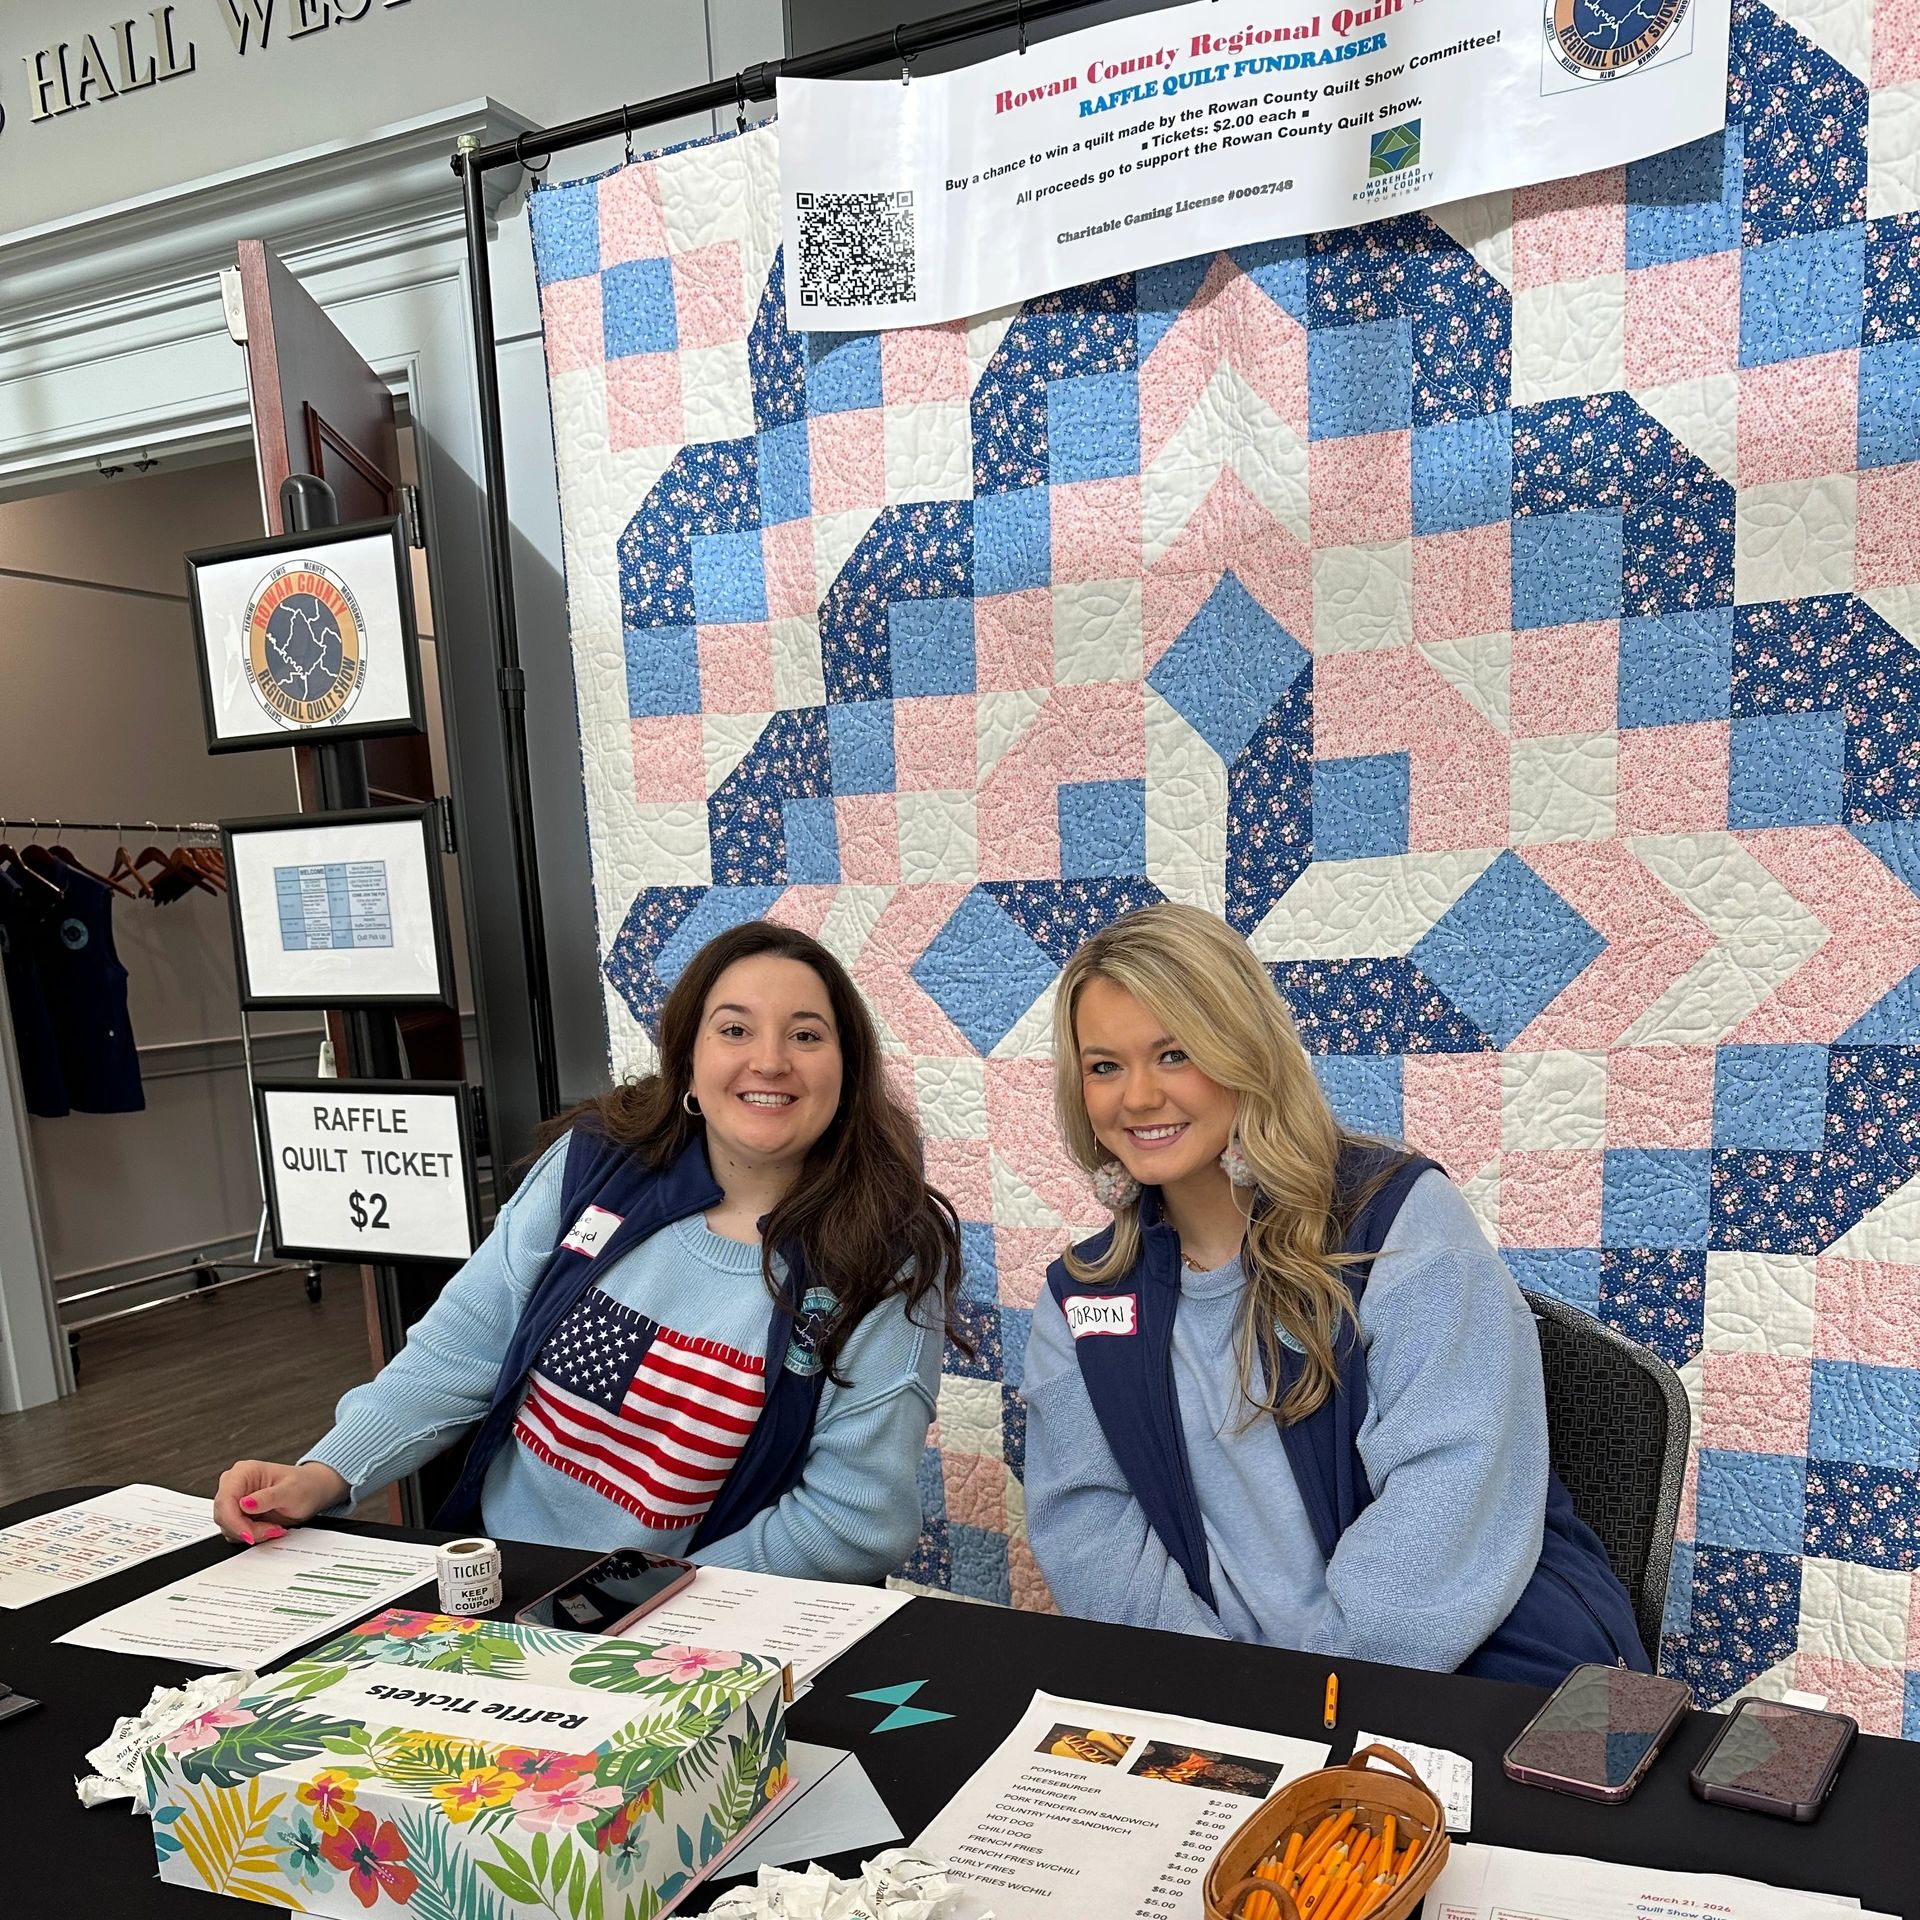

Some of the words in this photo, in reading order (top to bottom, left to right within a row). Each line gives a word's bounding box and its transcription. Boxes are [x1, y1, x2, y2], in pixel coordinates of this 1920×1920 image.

[1673, 0, 1688, 23] ORGAN
[1546, 17, 1556, 41] ELLIOTT
[1559, 24, 1608, 67] REGIONAL
[1612, 34, 1650, 66] QUILT
[1648, 0, 1678, 38] SHOW
[22, 6, 196, 124] HALL
[996, 73, 1077, 115] Rowan
[1087, 45, 1179, 85] County
[1189, 16, 1320, 59] Regional
[1332, 0, 1403, 37] Quilt
[1561, 56, 1581, 74] CARTER
[1638, 45, 1660, 66] ROWAN
[1079, 80, 1158, 118] RAFFLE
[1162, 64, 1230, 97] QUILT
[1234, 32, 1388, 80] FUNDRAISER
[1600, 70, 1616, 79] BATH
[945, 176, 969, 191] Buy
[972, 174, 980, 184] a
[983, 158, 1025, 182] chance
[1030, 151, 1042, 165] to
[1045, 144, 1068, 160] win
[1073, 141, 1081, 152] a
[1084, 128, 1115, 152] quilt
[1118, 119, 1155, 140] made
[1160, 114, 1176, 129] by
[1180, 107, 1203, 123] the
[1208, 98, 1258, 117] Rowan
[1263, 89, 1318, 107] County
[1323, 78, 1360, 97] Quilt
[1364, 64, 1404, 87] Show
[1409, 29, 1501, 70] Committee!
[1151, 125, 1209, 148] Tickets:
[1213, 114, 1254, 133] $2.00
[1258, 108, 1296, 124] each
[1016, 192, 1032, 205] All
[1035, 173, 1095, 202] proceeds
[1098, 168, 1115, 185] go
[1119, 162, 1132, 174] to
[1136, 148, 1190, 171] support
[1194, 142, 1217, 156] the
[1222, 130, 1272, 149] Rowan
[1278, 121, 1333, 140] County
[1338, 111, 1375, 130] Quilt
[1379, 97, 1422, 118] Show.
[1352, 186, 1389, 201] ROWAN
[1394, 171, 1435, 191] COUNTY
[1366, 168, 1421, 191] MOREHEAD
[1366, 186, 1421, 205] TOURISM
[1057, 217, 1121, 245] Charitable
[1124, 205, 1173, 228] Gaming
[1175, 193, 1225, 215] License
[1228, 179, 1294, 202] #0002748
[270, 566, 287, 581] LEWIS
[304, 562, 327, 576] MENIFEE
[244, 602, 256, 633] FLEMING
[254, 576, 294, 630] ROWAN
[297, 574, 348, 617] COUNTY
[340, 585, 365, 632] MONTGOMERY
[258, 669, 304, 719] REGIONAL
[306, 692, 337, 721] QUILT
[333, 656, 356, 699] SHOW
[354, 659, 366, 690] MORGAN
[313, 1106, 408, 1133] RAFFLE
[282, 1146, 348, 1172] QUILT
[361, 1150, 453, 1178] TICKET
[349, 1189, 390, 1232] $2
[1068, 1305, 1124, 1329] JORDYN
[453, 1561, 491, 1579] TICKET
[455, 1597, 495, 1611] COUPON
[461, 1587, 488, 1598] KEEP
[364, 1684, 479, 1714] Tickets
[481, 1703, 589, 1729] Raffle
[1012, 1784, 1077, 1801] HAMBURGER
[1195, 1819, 1225, 1830] $6.00
[1020, 1774, 1102, 1794] CHEESEBURGER
[1202, 1809, 1232, 1820] $7.00
[1208, 1800, 1238, 1809] $2.00
[995, 1803, 1045, 1818] COUNTRY
[1045, 1813, 1071, 1823] HAM
[1071, 1818, 1132, 1836] SANDWICH
[1182, 1840, 1212, 1851] $6.00
[1004, 1793, 1031, 1804] PORK
[1034, 1798, 1098, 1816] TENDERLOIN
[1099, 1812, 1160, 1829] SANDWICH
[1189, 1829, 1219, 1840] $6.00
[977, 1823, 1005, 1834] CHILI
[1006, 1829, 1032, 1839] DOG
[1167, 1863, 1198, 1874] $4.00
[986, 1813, 1009, 1822] HOT
[1009, 1819, 1034, 1828] DOG
[1174, 1852, 1205, 1863] $3.00
[958, 1844, 1004, 1859] FRENCH
[1004, 1854, 1035, 1866] FRIES
[1036, 1861, 1080, 1876] W/CHILI
[1152, 1886, 1183, 1897] $6.00
[968, 1834, 1012, 1847] FRENCH
[1012, 1843, 1044, 1854] FRIES
[1160, 1874, 1191, 1885] $5.00
[947, 1868, 974, 1879] URLY
[975, 1875, 1006, 1887] FRIES
[1007, 1882, 1052, 1897] W/CHILI
[1135, 1909, 1168, 1920] $6.00
[949, 1856, 985, 1867] CURLY
[985, 1863, 1016, 1875] FRIES
[1144, 1898, 1176, 1909] $5.00
[1636, 1904, 1664, 1914] Quilt
[1666, 1909, 1699, 1919] Show
[1640, 1894, 1679, 1905] March
